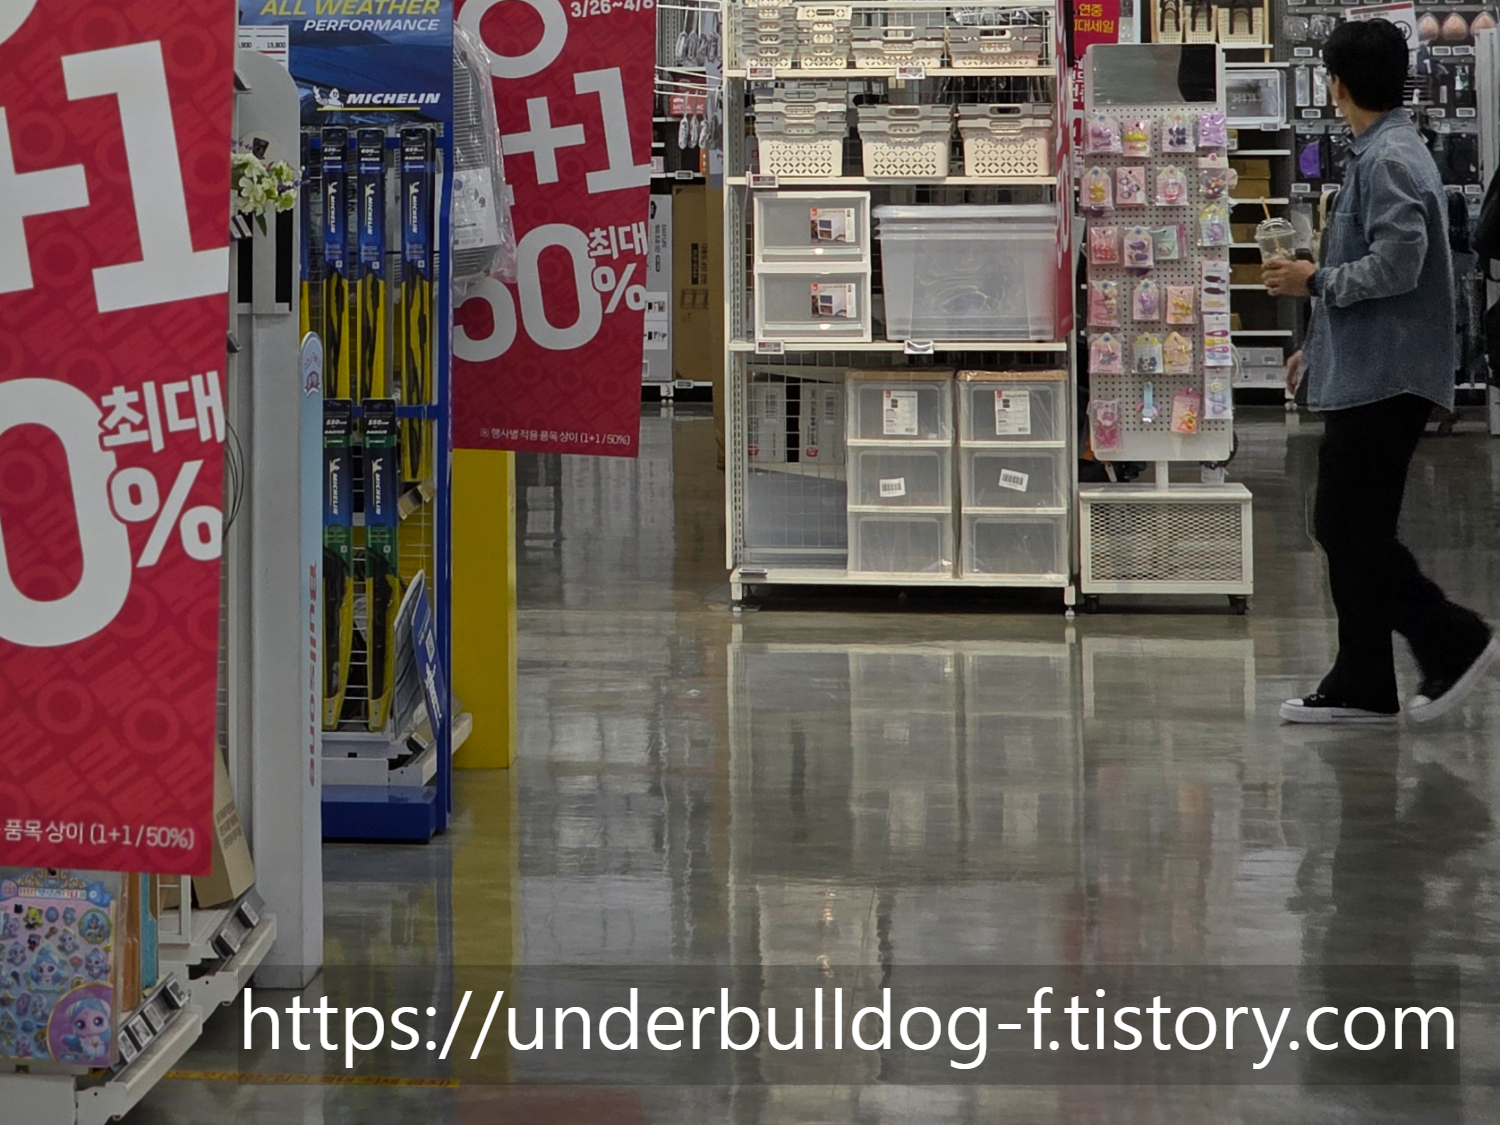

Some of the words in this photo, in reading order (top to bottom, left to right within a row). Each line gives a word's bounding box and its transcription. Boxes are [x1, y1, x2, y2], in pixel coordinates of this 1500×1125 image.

[260, 0, 307, 15] ALL
[1078, 3, 1103, 17] 연중
[303, 19, 441, 32] PERFORMANCE
[346, 92, 441, 105] MICHELIN
[501, 67, 651, 206] +1
[589, 221, 649, 260] 최대
[99, 370, 226, 454] 최대
[491, 428, 519, 441] 행사별
[520, 429, 538, 441] 적용
[540, 430, 558, 442] 품목
[559, 431, 578, 443] 상이
[4, 819, 43, 842] 품목
[45, 821, 84, 845] 상이
